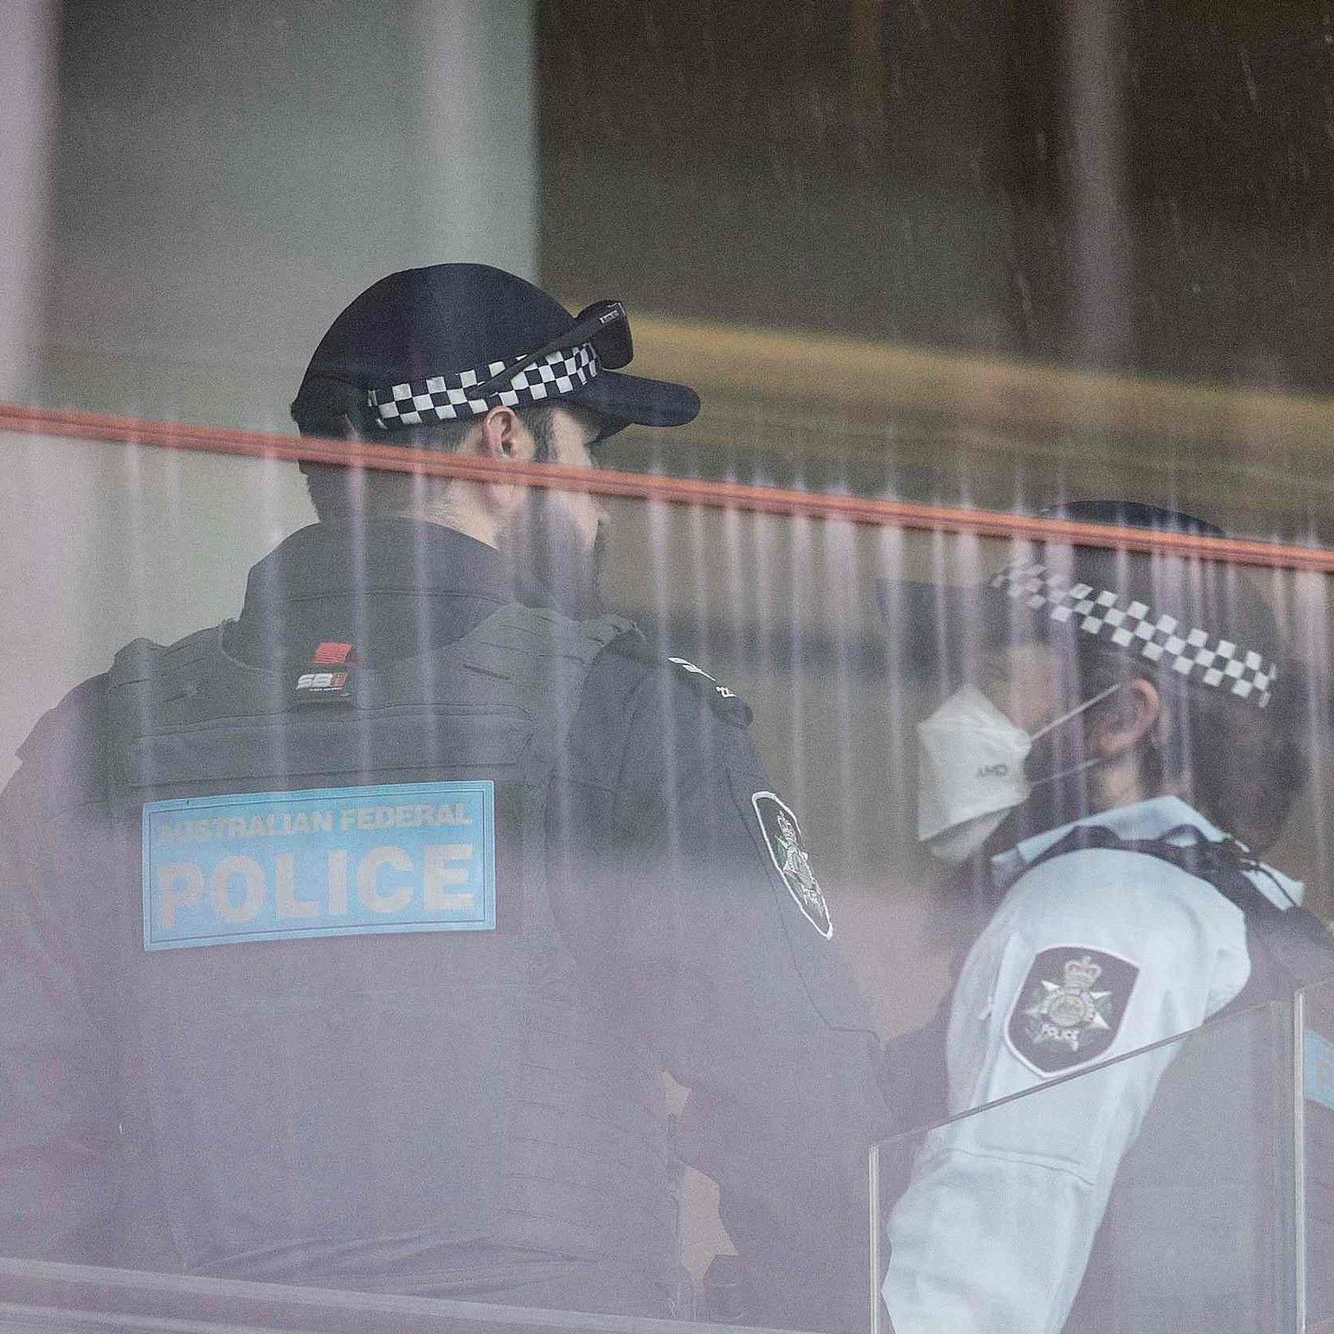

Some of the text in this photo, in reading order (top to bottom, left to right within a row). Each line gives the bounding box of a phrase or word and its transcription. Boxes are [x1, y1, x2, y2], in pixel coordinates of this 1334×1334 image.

[159, 803, 473, 843] AUSTRALIAN FEDERAL
[157, 843, 474, 930] POLICE
